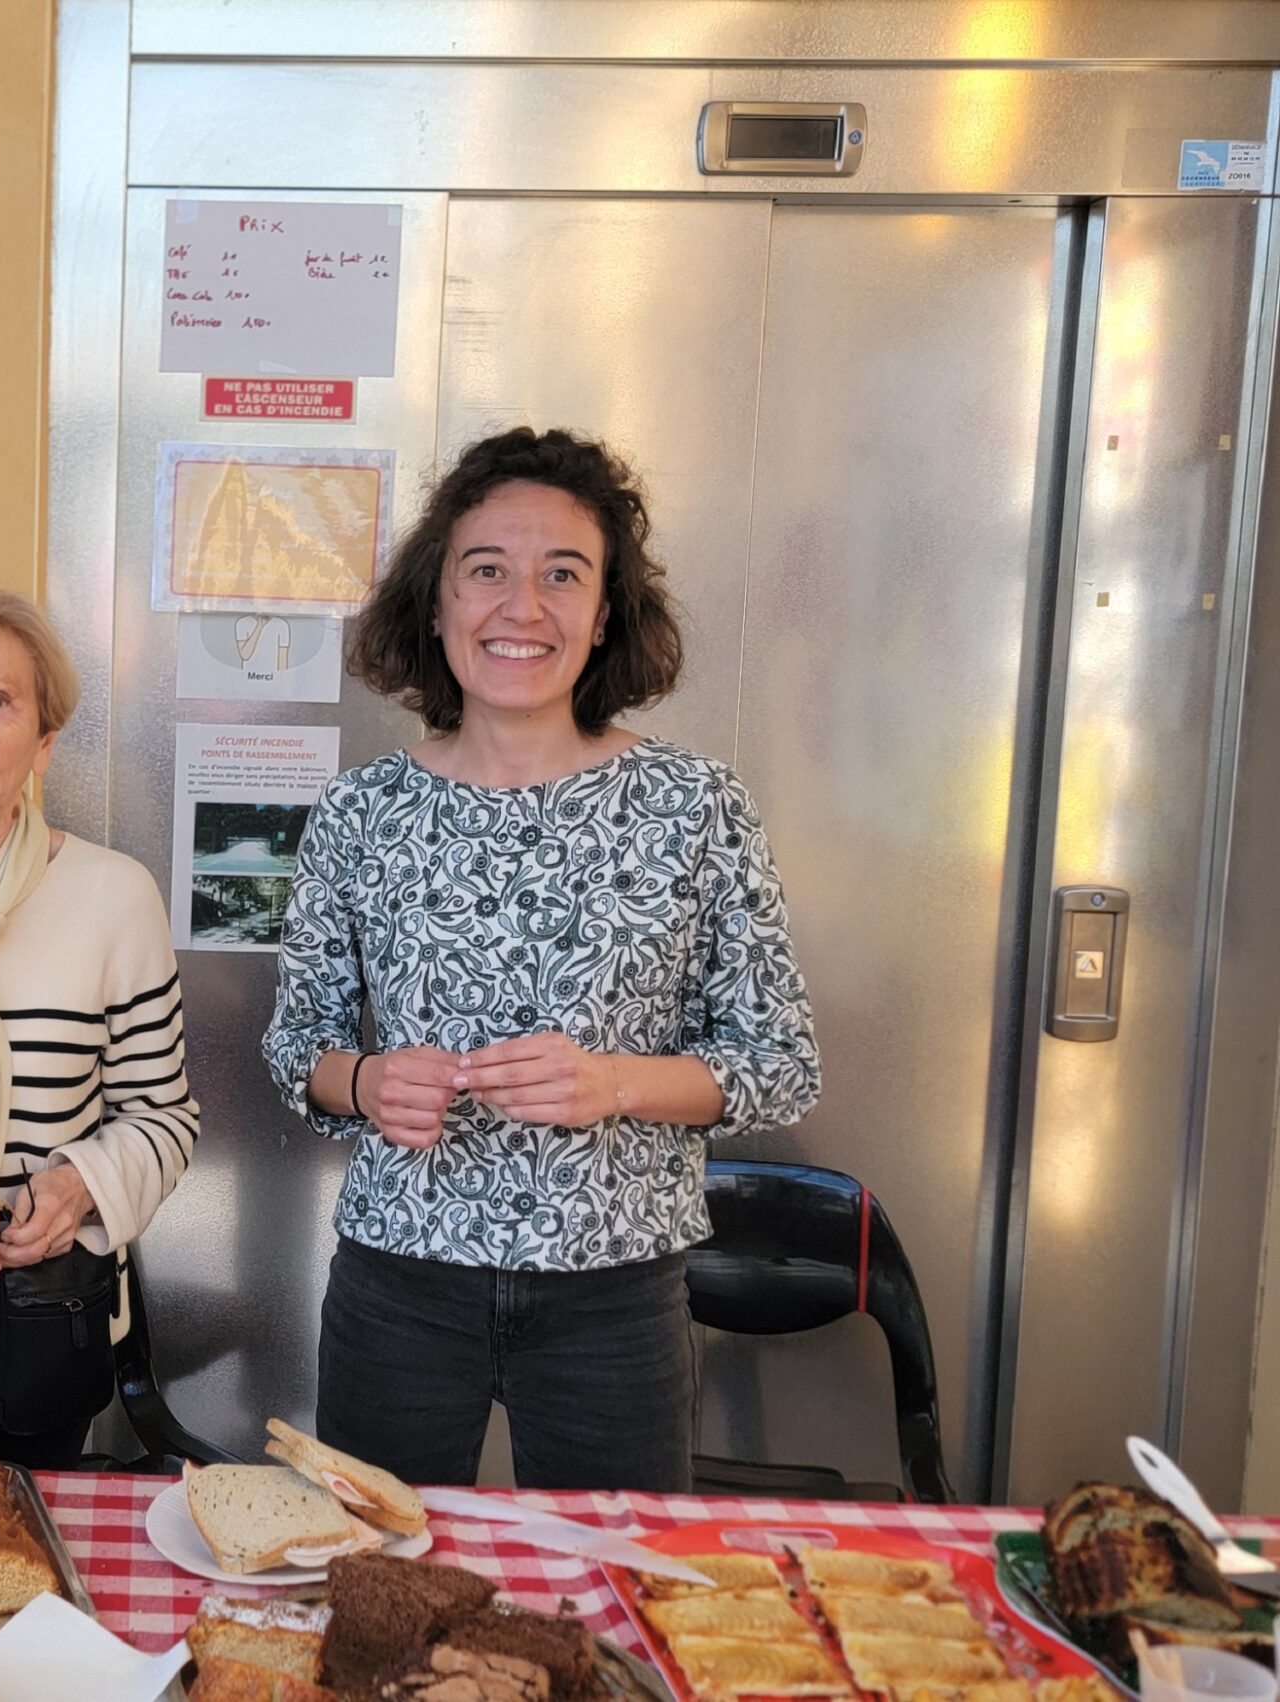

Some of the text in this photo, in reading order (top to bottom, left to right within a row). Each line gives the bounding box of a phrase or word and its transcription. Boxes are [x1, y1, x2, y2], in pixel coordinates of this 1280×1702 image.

[223, 382, 335, 394] NE PAS UTILISER
[235, 393, 323, 405] L'ASCENSEUR
[213, 404, 343, 416] EN CAS D'INCENDIE
[247, 672, 274, 681] Merci
[215, 735, 305, 748] SÉCURITÉ INCENDIE
[201, 749, 318, 761] POINTS DE RASSEMBLEMENT
